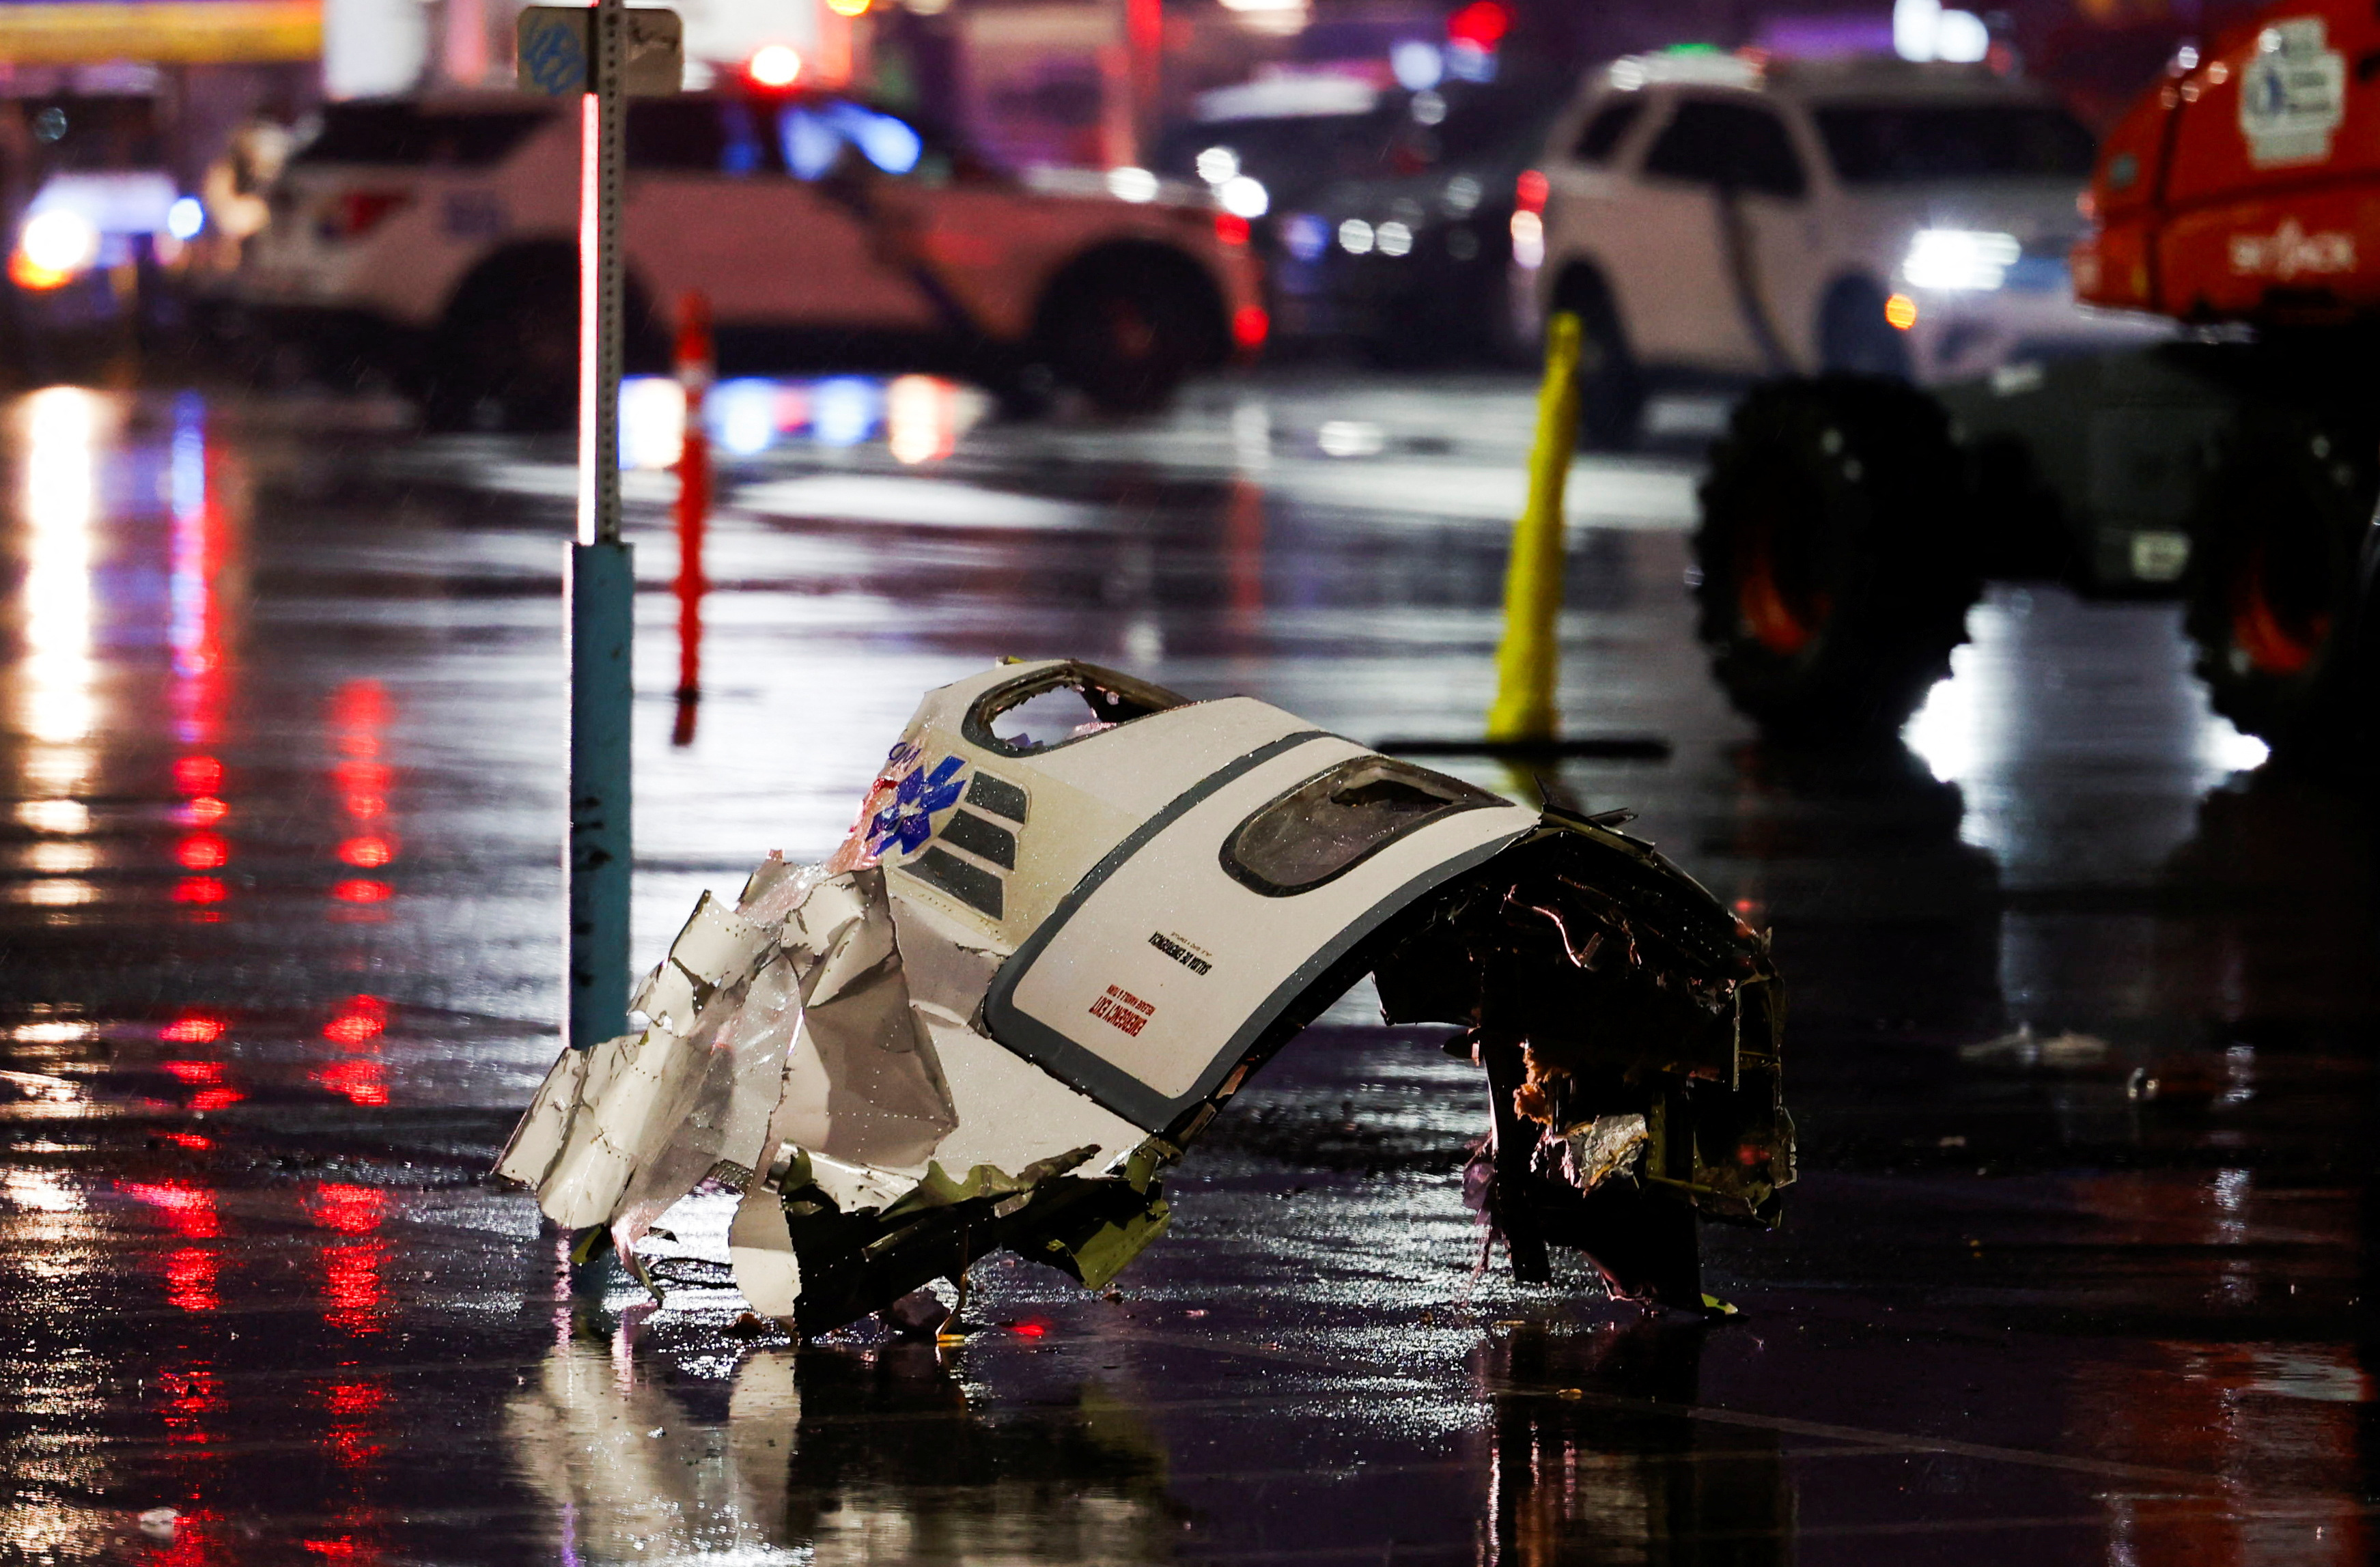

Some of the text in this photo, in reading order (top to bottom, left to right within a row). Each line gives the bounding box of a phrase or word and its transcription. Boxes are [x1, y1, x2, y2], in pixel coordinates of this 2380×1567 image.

[1148, 931, 1212, 976] SALIDA DE EMERGENCIA
[1089, 996, 1148, 1037] EMERGENCY EXIT
[1135, 1000, 1156, 1016] RELEASE
